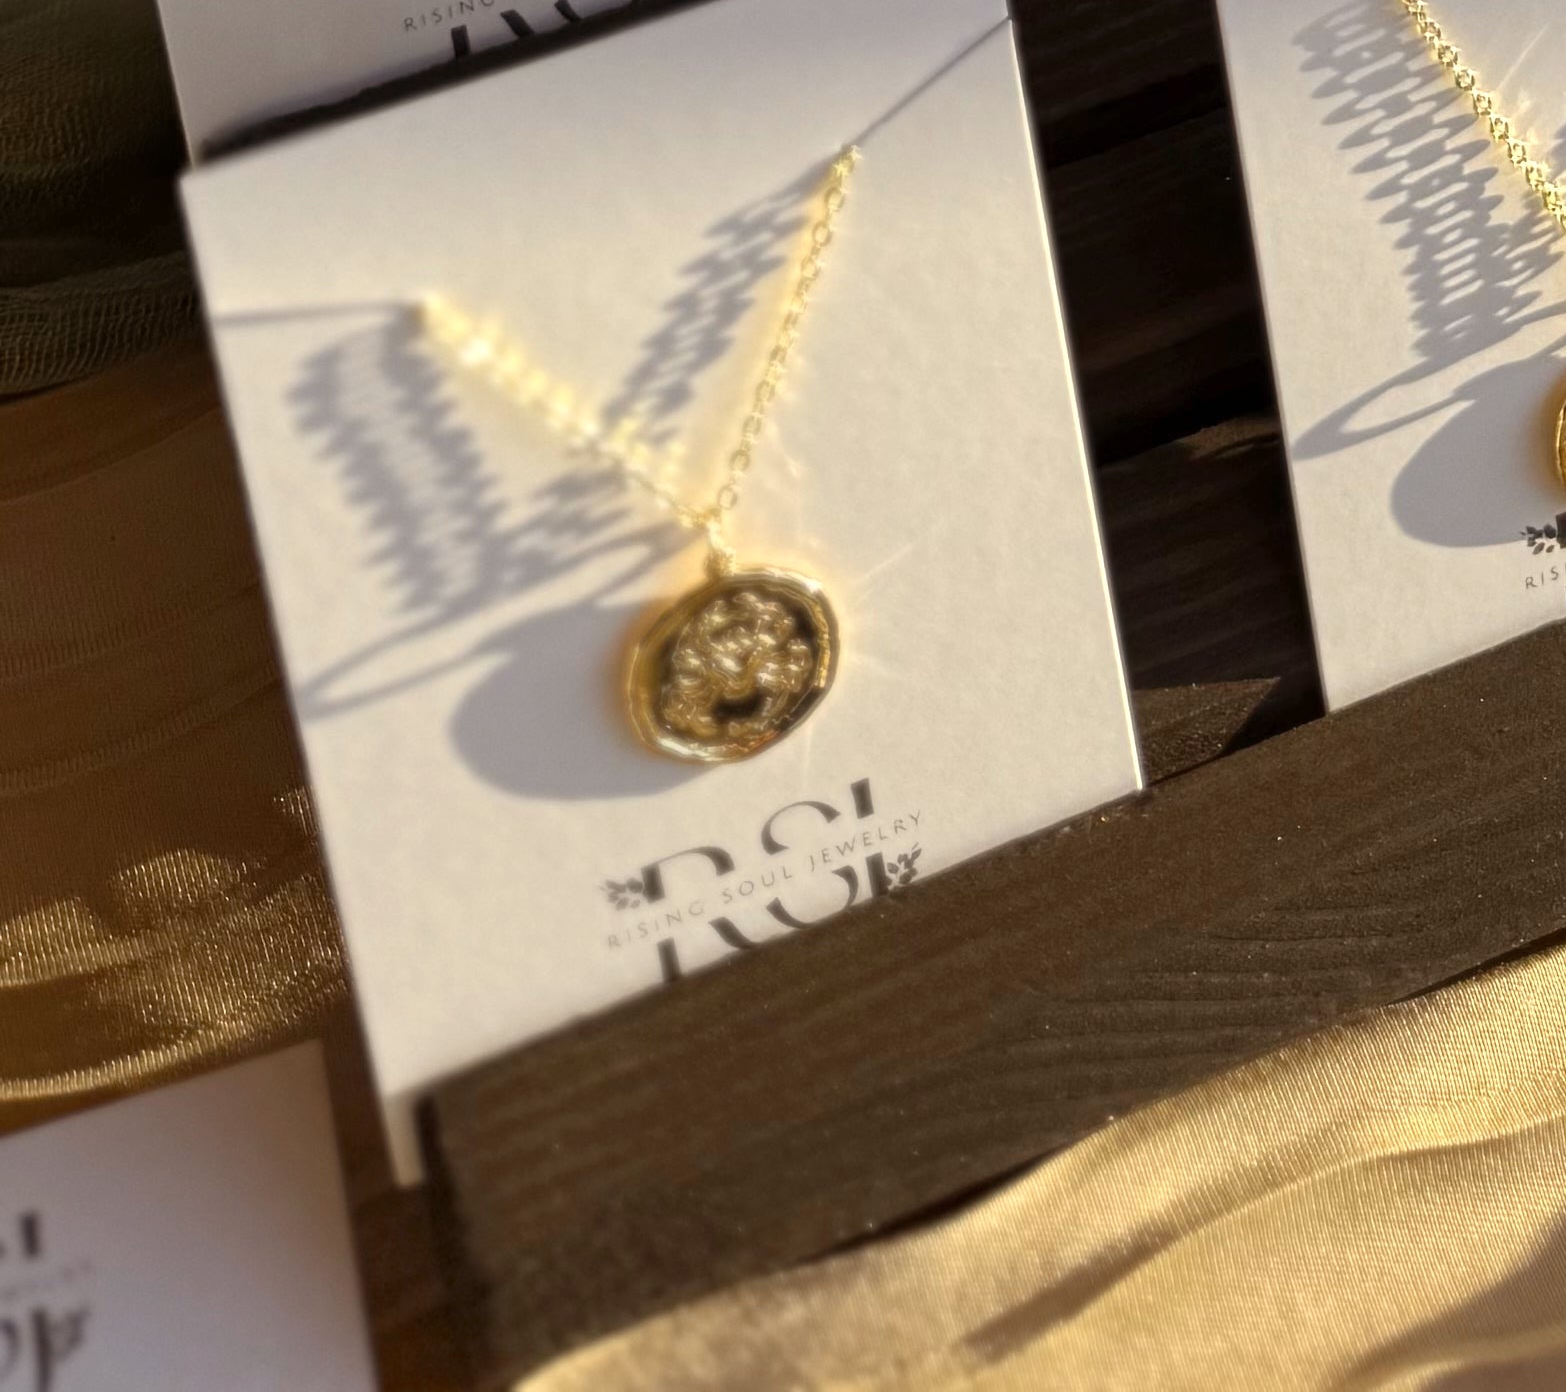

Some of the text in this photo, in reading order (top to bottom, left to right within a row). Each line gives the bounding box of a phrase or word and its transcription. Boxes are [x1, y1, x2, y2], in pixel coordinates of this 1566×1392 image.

[607, 810, 921, 949] RISING SOUL JEWELRY
